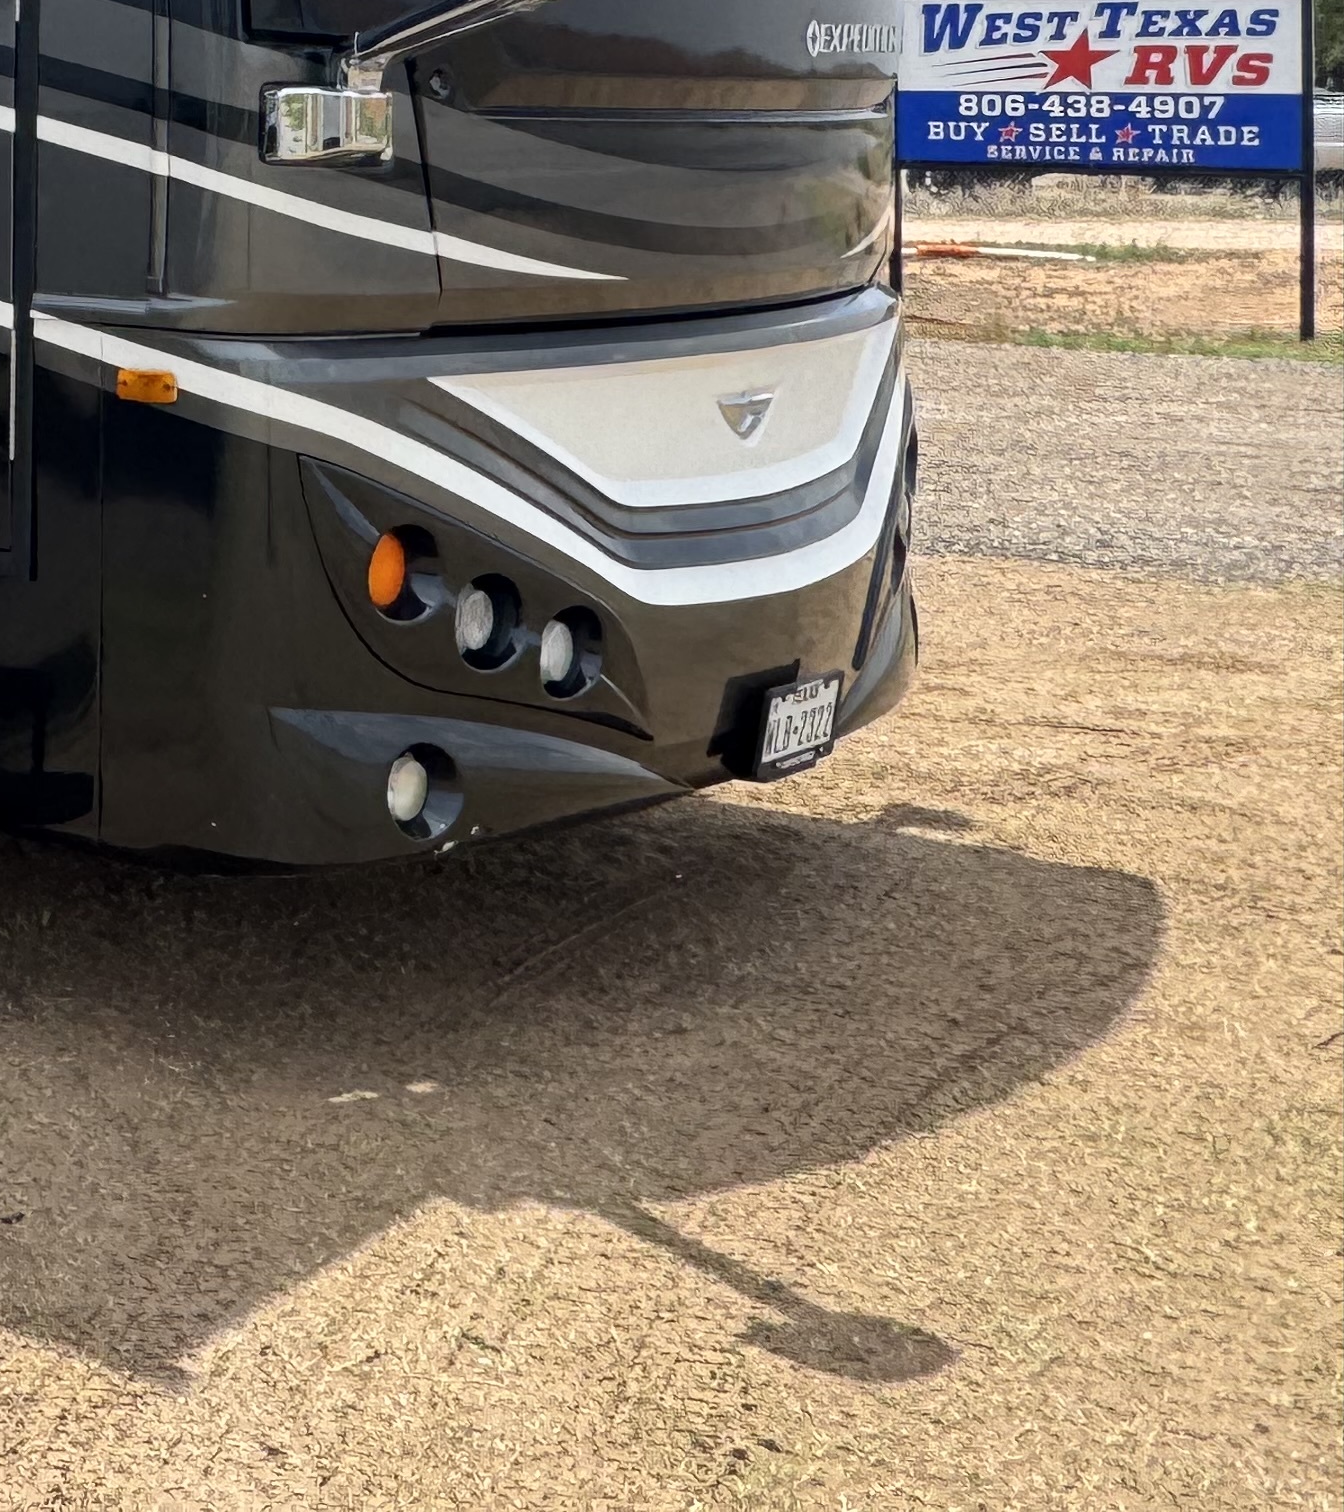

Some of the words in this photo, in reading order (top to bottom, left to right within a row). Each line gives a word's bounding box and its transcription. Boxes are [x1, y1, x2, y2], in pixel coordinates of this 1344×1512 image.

[921, 3, 1079, 54] WEST
[1094, 1, 1280, 39] TEXAS
[958, 94, 1226, 120] 806-438-4907
[927, 121, 990, 141] BUY
[1029, 123, 1107, 144] SELL
[1148, 125, 1261, 147] TRADE
[986, 144, 1081, 162] SERVICE
[1089, 146, 1104, 162] &
[1111, 147, 1197, 164] REPAIR
